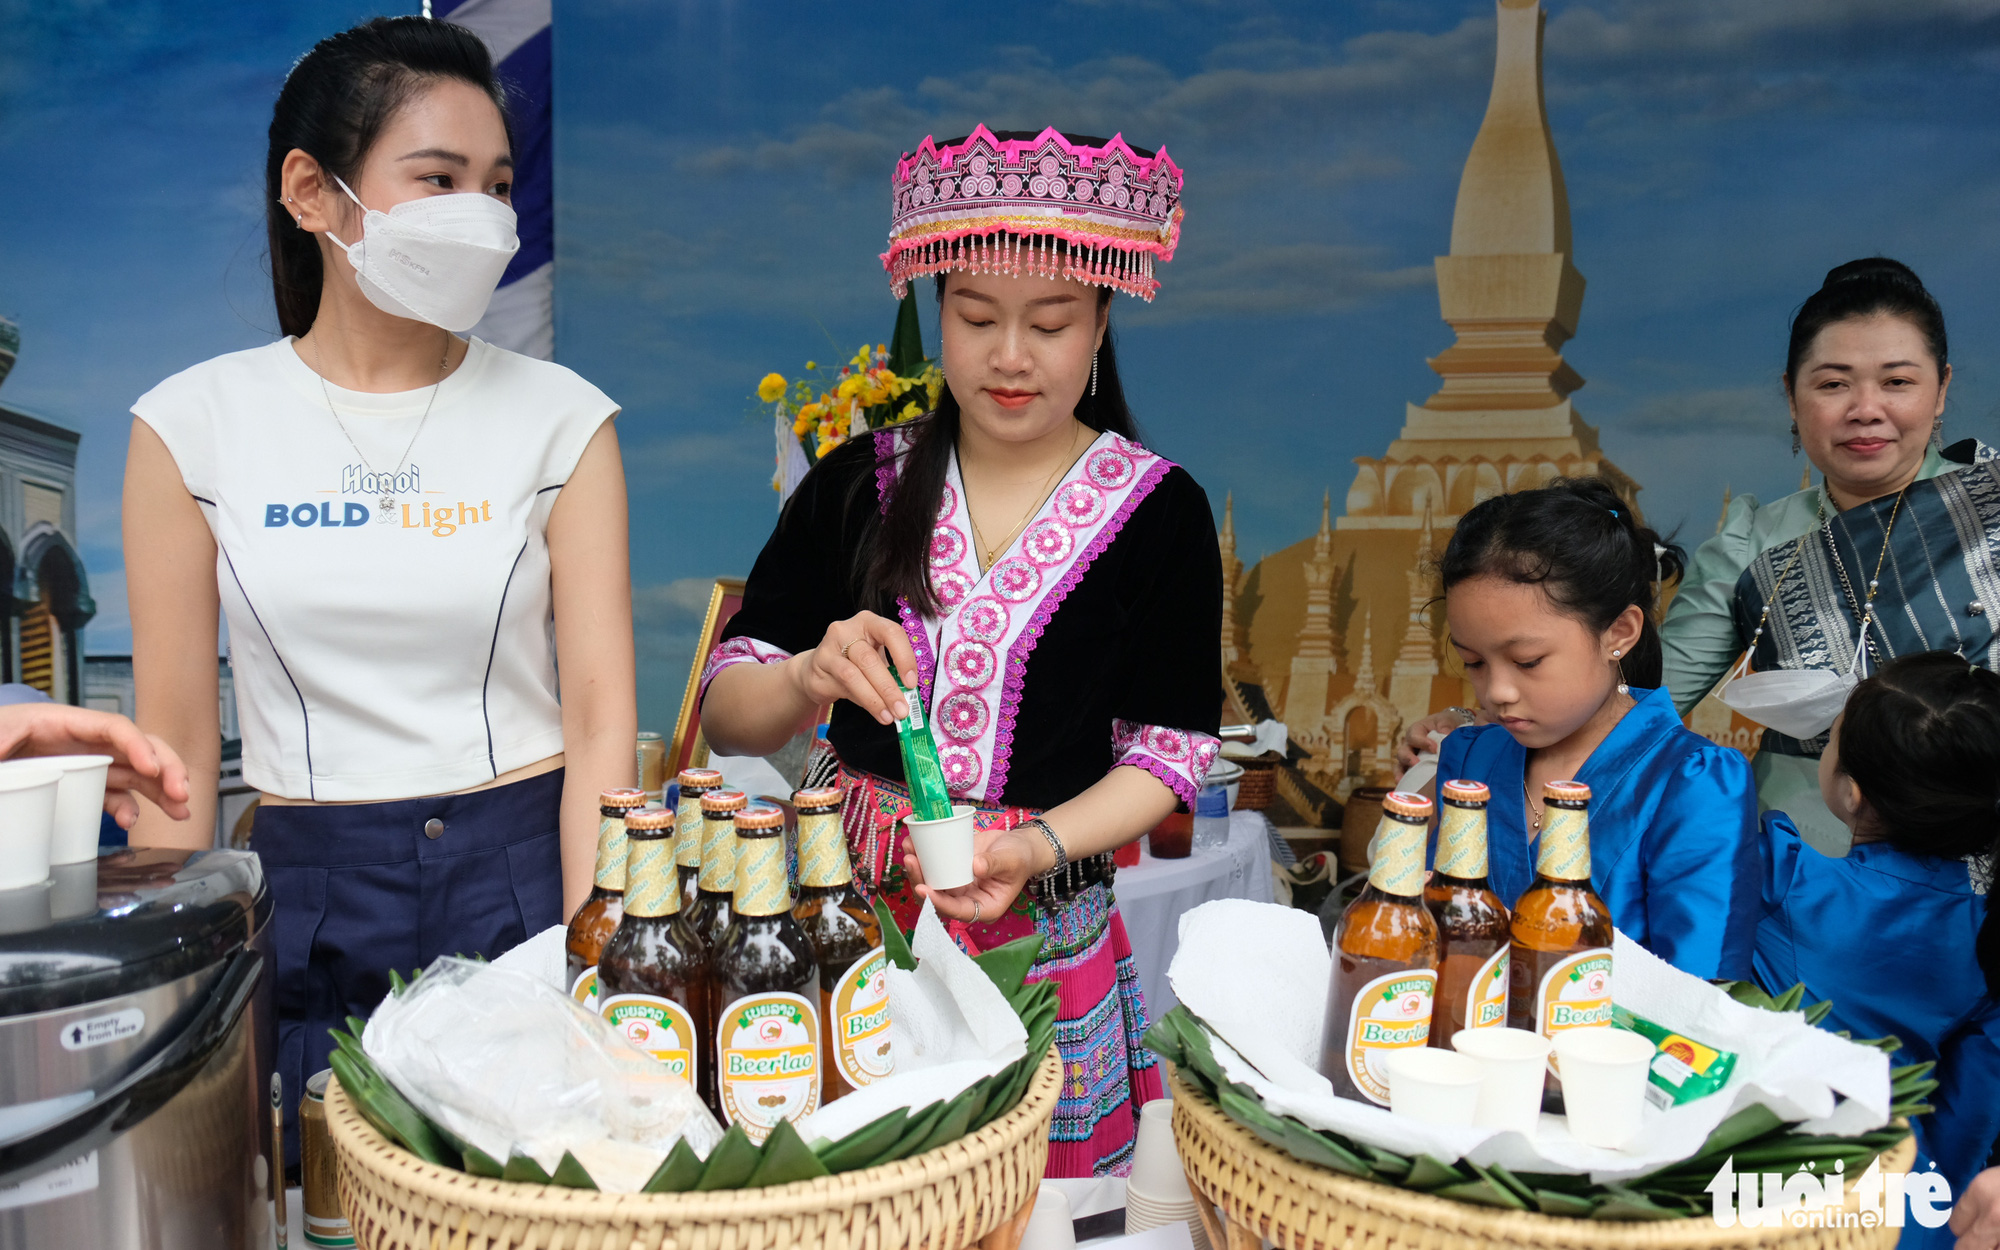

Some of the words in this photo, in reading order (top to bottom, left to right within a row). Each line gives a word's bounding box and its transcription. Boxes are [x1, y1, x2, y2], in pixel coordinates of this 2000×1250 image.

[342, 463, 420, 494] Hanoi
[264, 501, 370, 527] BOLD
[401, 499, 493, 537] Light
[1448, 815, 1480, 846] Beerlao
[746, 841, 780, 876] Beerlao
[87, 1018, 120, 1031] Empty
[87, 1031, 111, 1042] from
[115, 1024, 136, 1036] here
[729, 1053, 812, 1074] Beerlao
[1354, 1056, 1365, 1074] LAO
